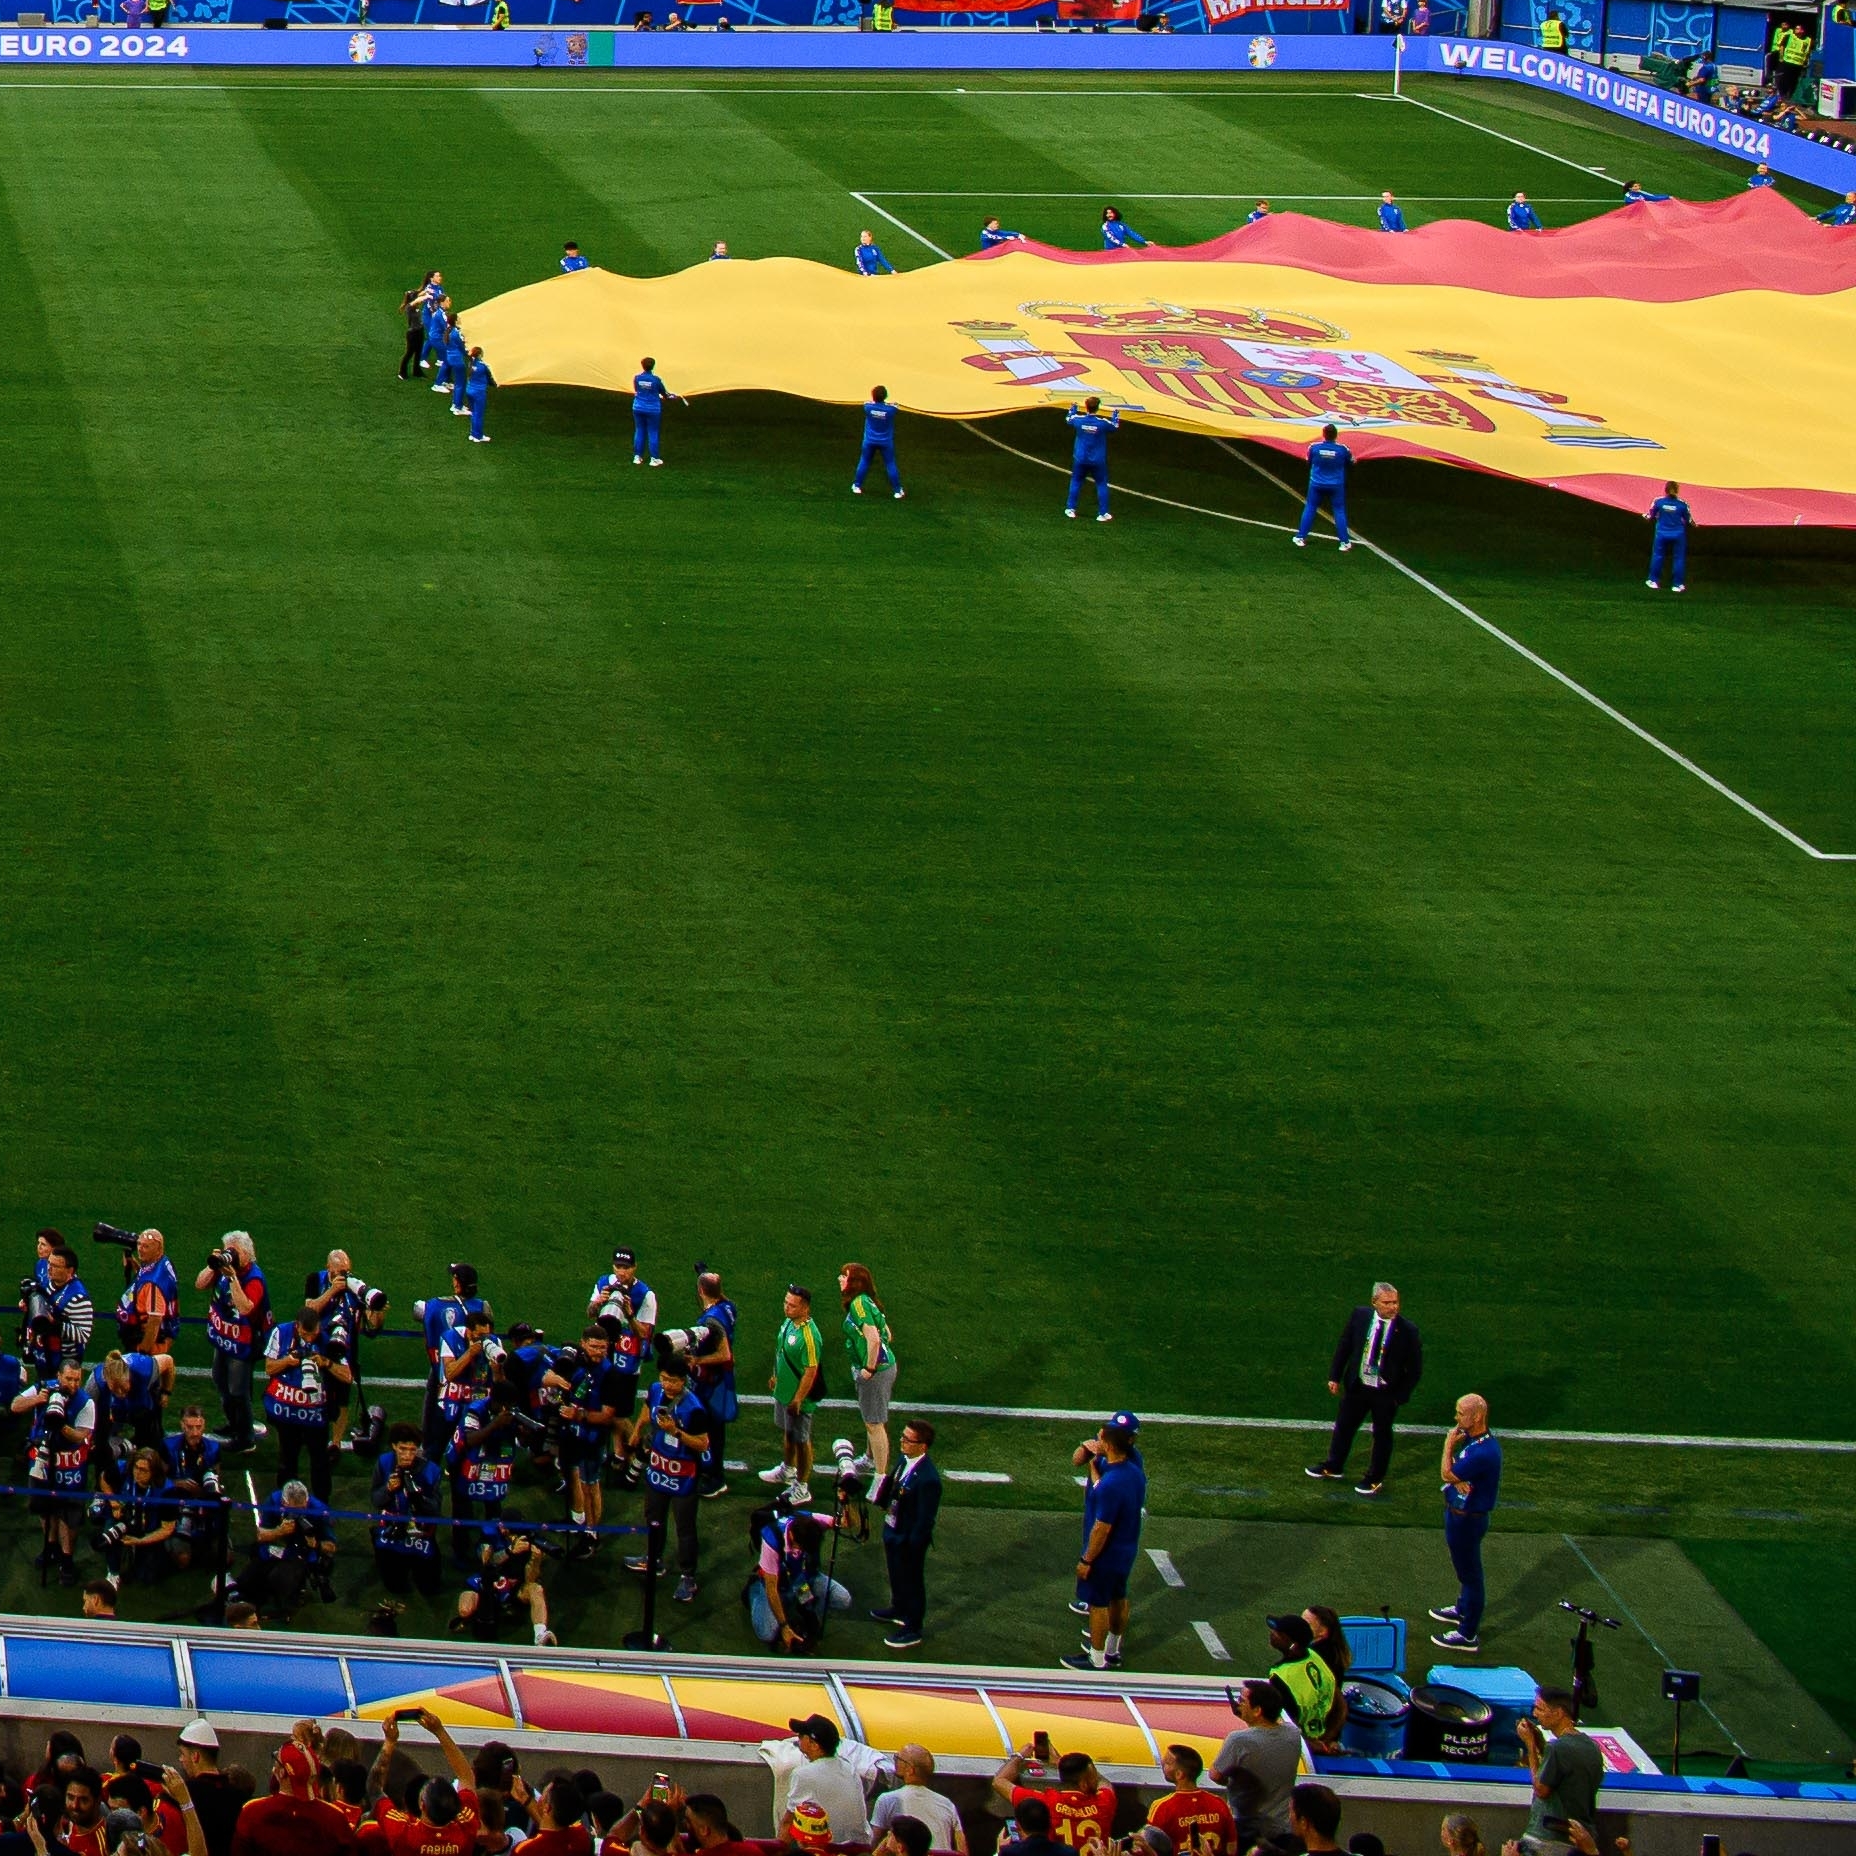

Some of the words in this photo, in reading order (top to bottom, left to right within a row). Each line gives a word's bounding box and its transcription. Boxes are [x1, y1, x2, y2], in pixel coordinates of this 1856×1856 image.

[100, 35, 188, 57] 2024
[1440, 42, 1585, 93] WELCOME
[1587, 73, 1611, 102] TO
[1612, 81, 1663, 122] UEFA
[1663, 99, 1718, 138] EURO
[1719, 118, 1771, 158] 2024
[1439, 1743, 1488, 1757] RECYCL
